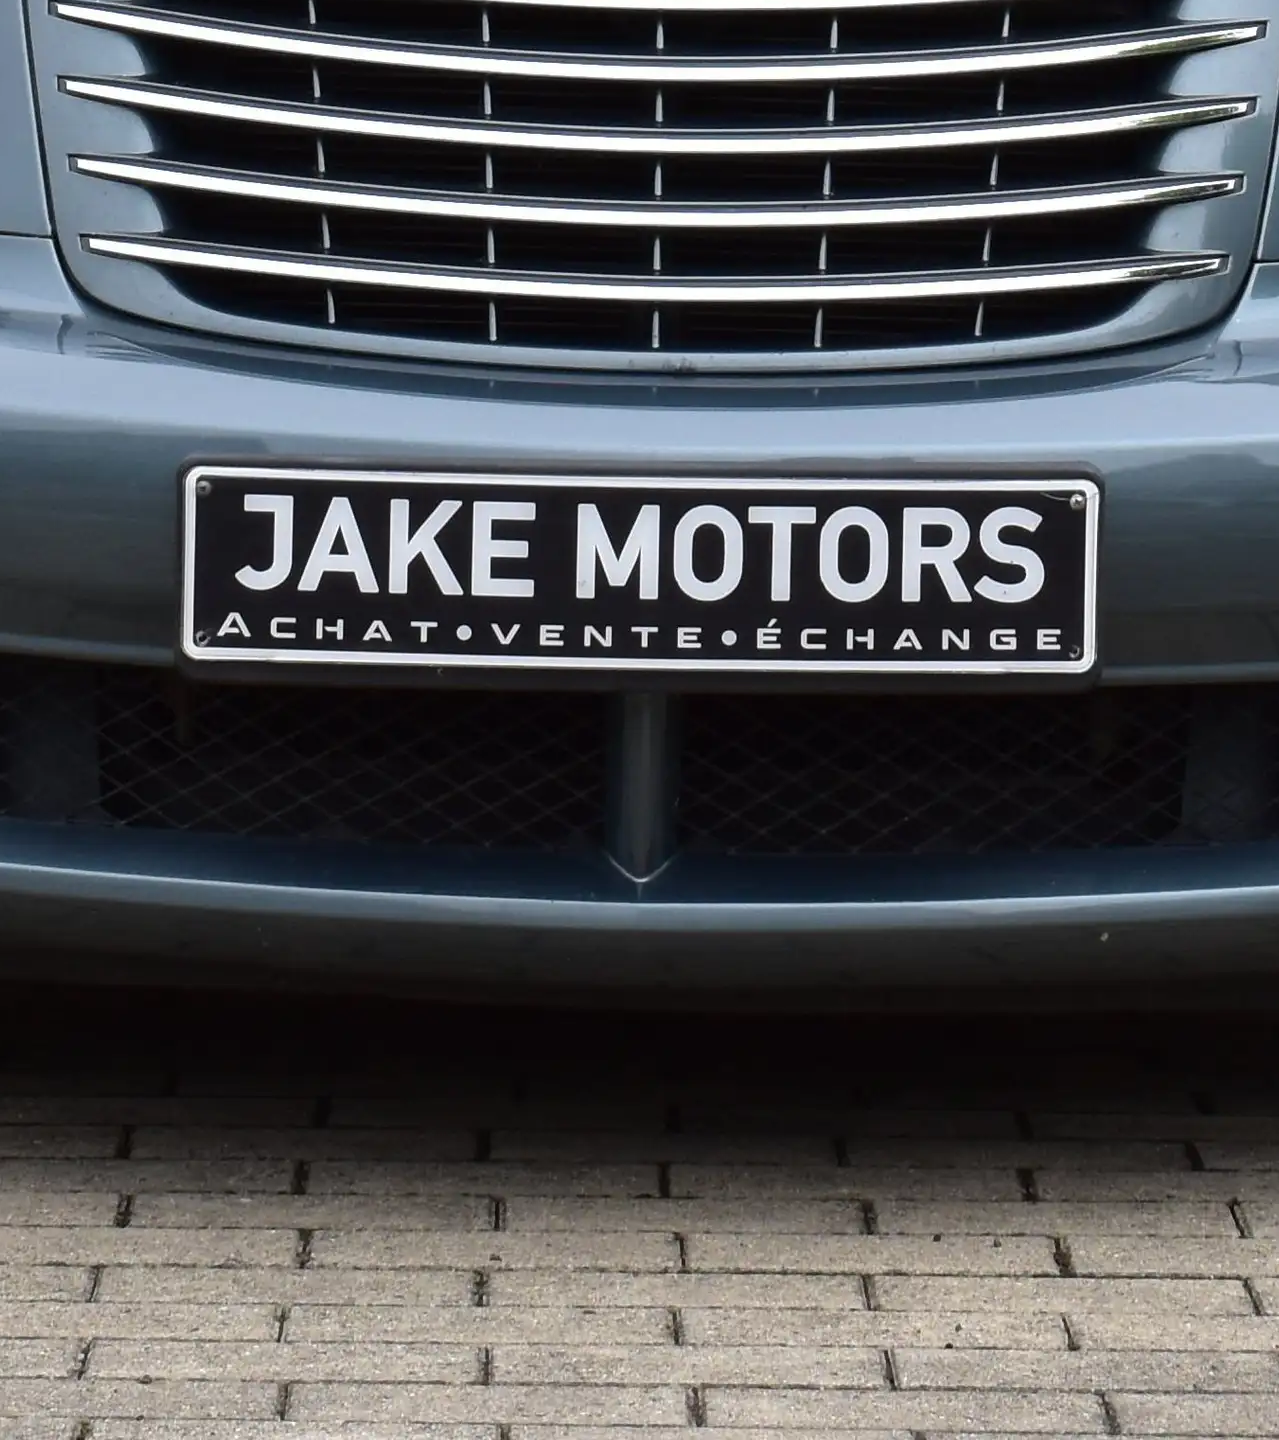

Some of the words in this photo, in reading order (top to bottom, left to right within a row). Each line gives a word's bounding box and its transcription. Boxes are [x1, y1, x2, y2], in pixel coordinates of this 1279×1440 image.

[234, 493, 537, 598] JAKE
[575, 504, 1045, 604] MOTORS
[216, 612, 438, 643] ACHAT
[491, 623, 702, 649] VENTE
[756, 617, 1062, 651] ÉCHANGE
